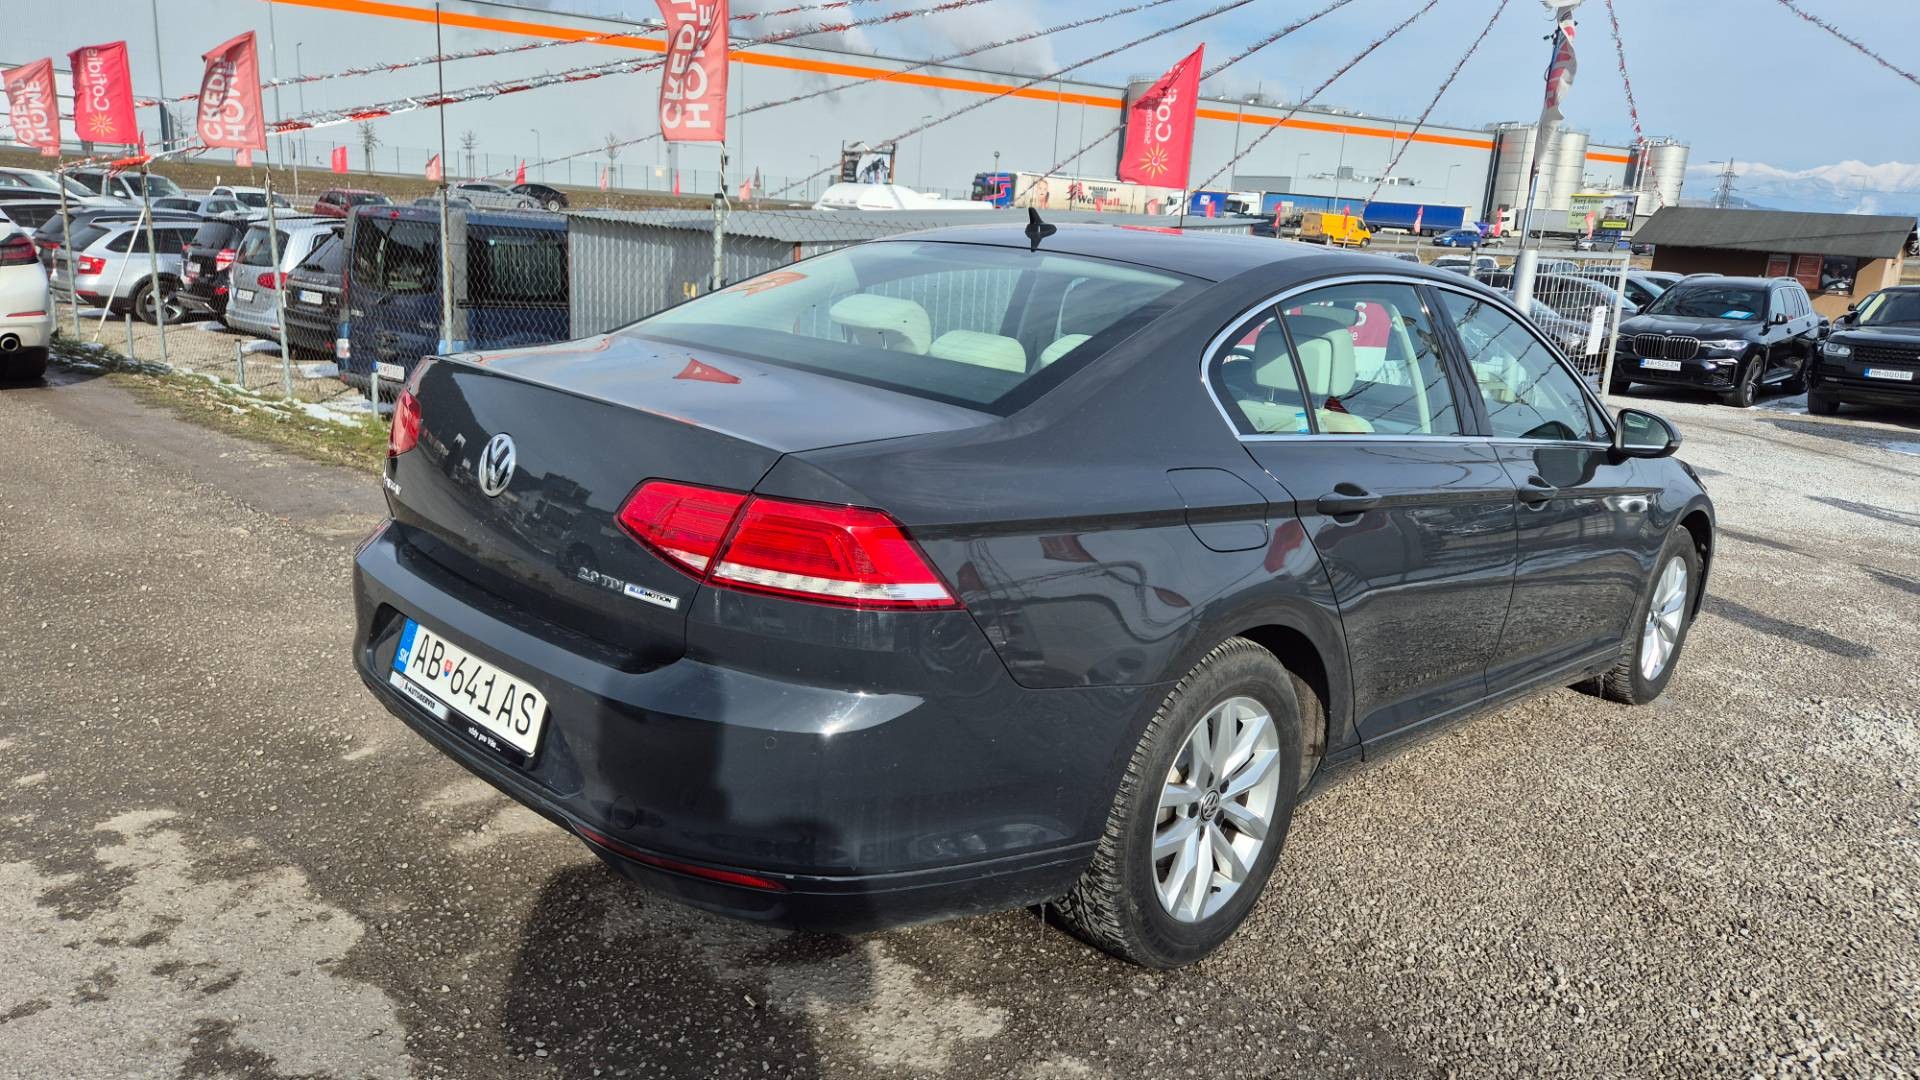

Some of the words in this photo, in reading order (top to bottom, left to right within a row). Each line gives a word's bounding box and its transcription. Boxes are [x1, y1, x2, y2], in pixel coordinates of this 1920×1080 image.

[578, 567, 599, 582] 2.0
[601, 574, 624, 592] TDI
[629, 586, 672, 604] BLUEMOTION
[399, 648, 409, 664] SK
